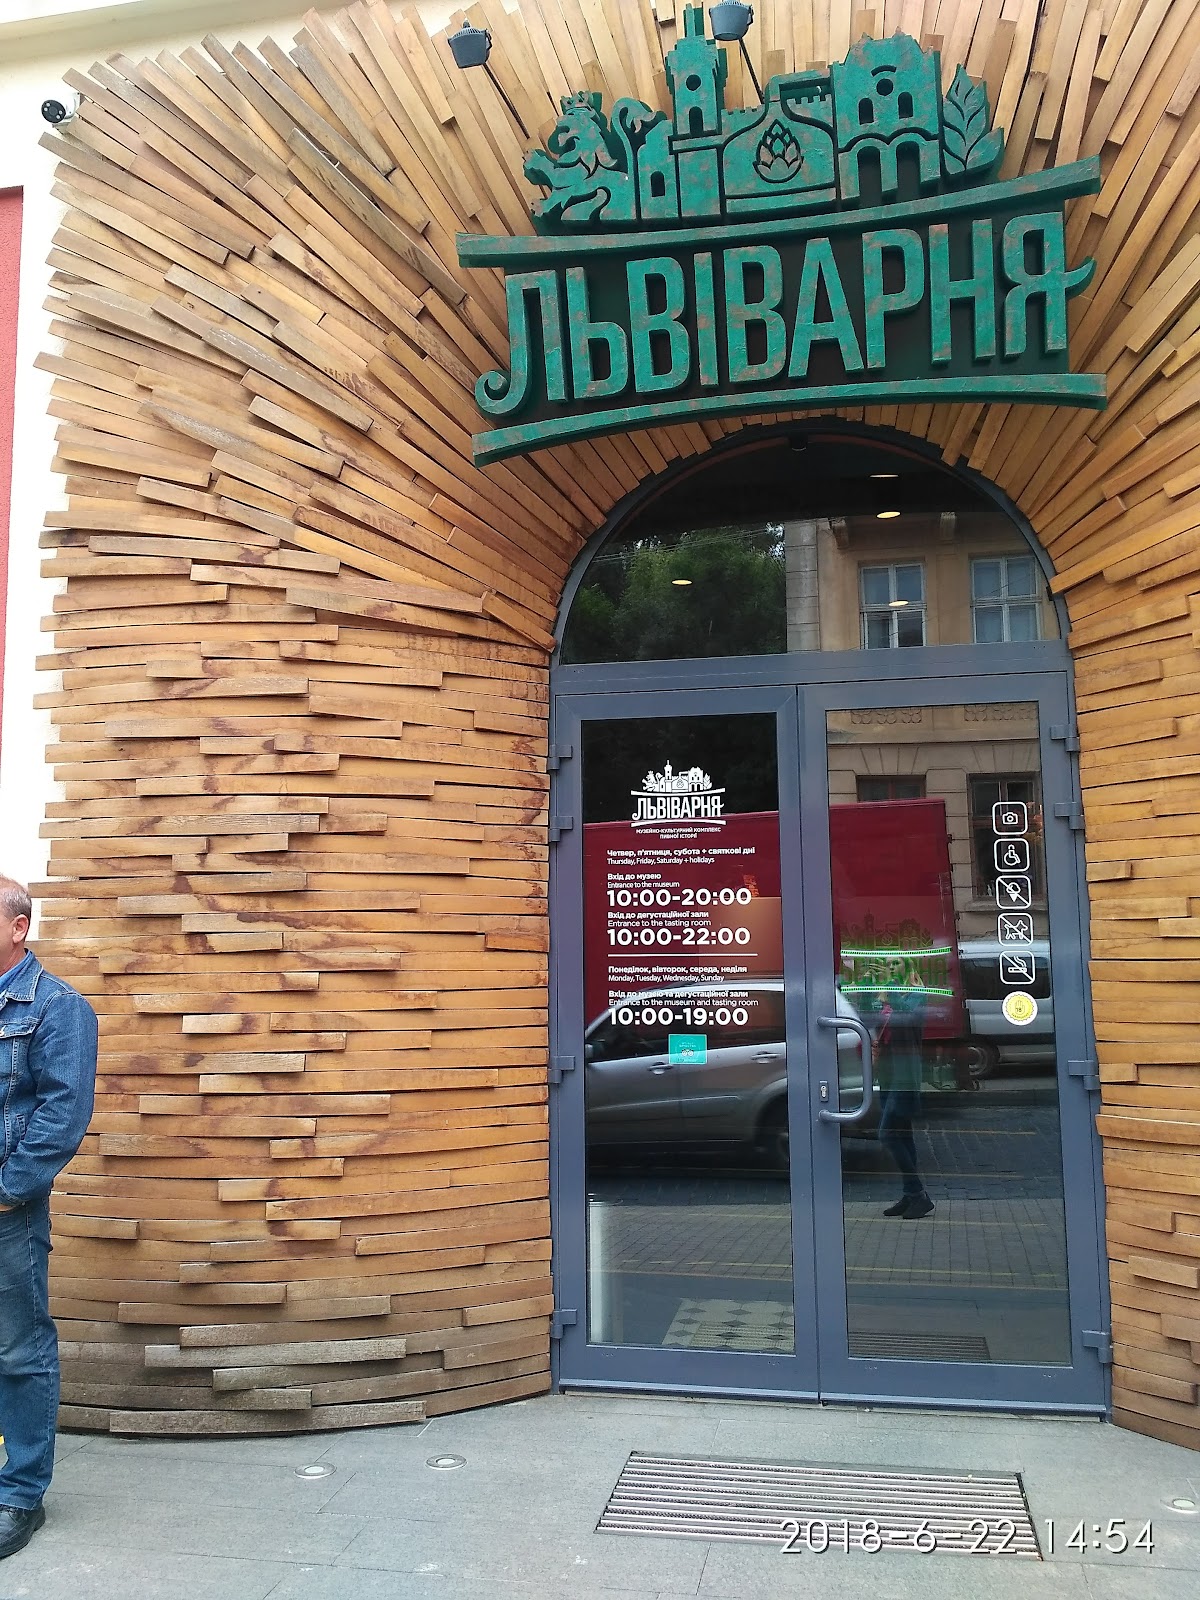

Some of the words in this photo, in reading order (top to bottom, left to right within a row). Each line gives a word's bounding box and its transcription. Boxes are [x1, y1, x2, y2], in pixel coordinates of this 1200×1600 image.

[474, 212, 1096, 415] ЛЬВІВАРНЯ
[631, 795, 725, 820] ЛЬВІВАРНЯ
[673, 848, 700, 856] субота
[708, 847, 741, 855] святкові
[743, 847, 755, 855] дні
[607, 858, 636, 866] Thursday,
[657, 857, 683, 865] Saturday
[690, 856, 715, 864] holidays
[607, 881, 634, 889] Entrance
[607, 888, 751, 906] 10:00-20:00
[607, 911, 624, 919] Вхід
[637, 911, 690, 919] дегустаційної
[664, 919, 689, 927] tasting
[607, 927, 750, 945] 10:00-22:00
[608, 966, 651, 974] Понеділок,
[652, 965, 688, 974] вівторок,
[689, 966, 719, 974] середа,
[721, 965, 747, 973] неділя
[608, 974, 635, 983] Monday,
[635, 974, 662, 983] Tuesday,
[662, 974, 700, 982] Wednesday,
[701, 974, 725, 982] Sunday
[608, 990, 625, 998] Вхід
[674, 990, 729, 998] дегустаційної
[650, 998, 663, 1006] the
[711, 998, 737, 1007] tasting
[608, 1008, 749, 1025] 10:00-19:00
